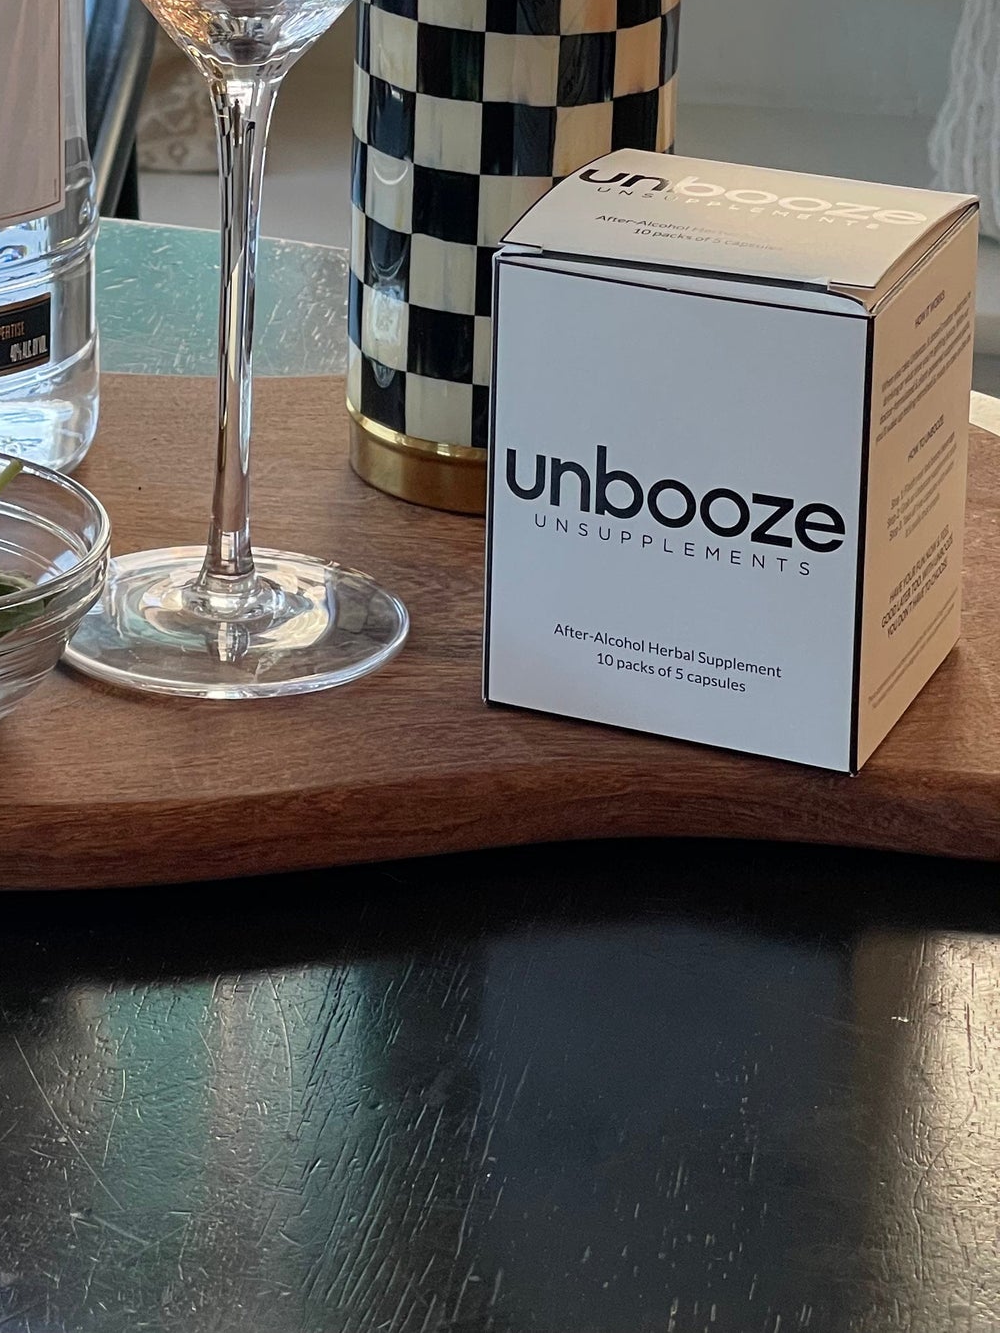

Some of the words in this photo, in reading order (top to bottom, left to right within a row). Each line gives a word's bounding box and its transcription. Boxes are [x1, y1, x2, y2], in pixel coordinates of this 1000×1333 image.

[578, 168, 927, 226] unbooze
[596, 186, 880, 230] UNSUPPLEMENTS
[596, 215, 690, 231] After-Alcohol
[652, 231, 692, 241] packs
[506, 444, 846, 553] unbooze
[535, 513, 811, 576] UNSUPPLEMENTS
[553, 623, 645, 652] After-Alcohol
[648, 641, 695, 662] Herbal
[698, 651, 782, 678] Supplement
[597, 652, 614, 666] 10
[616, 656, 655, 675] packs
[657, 666, 673, 677] of
[675, 668, 684, 680] 5
[687, 672, 746, 693] capsules
